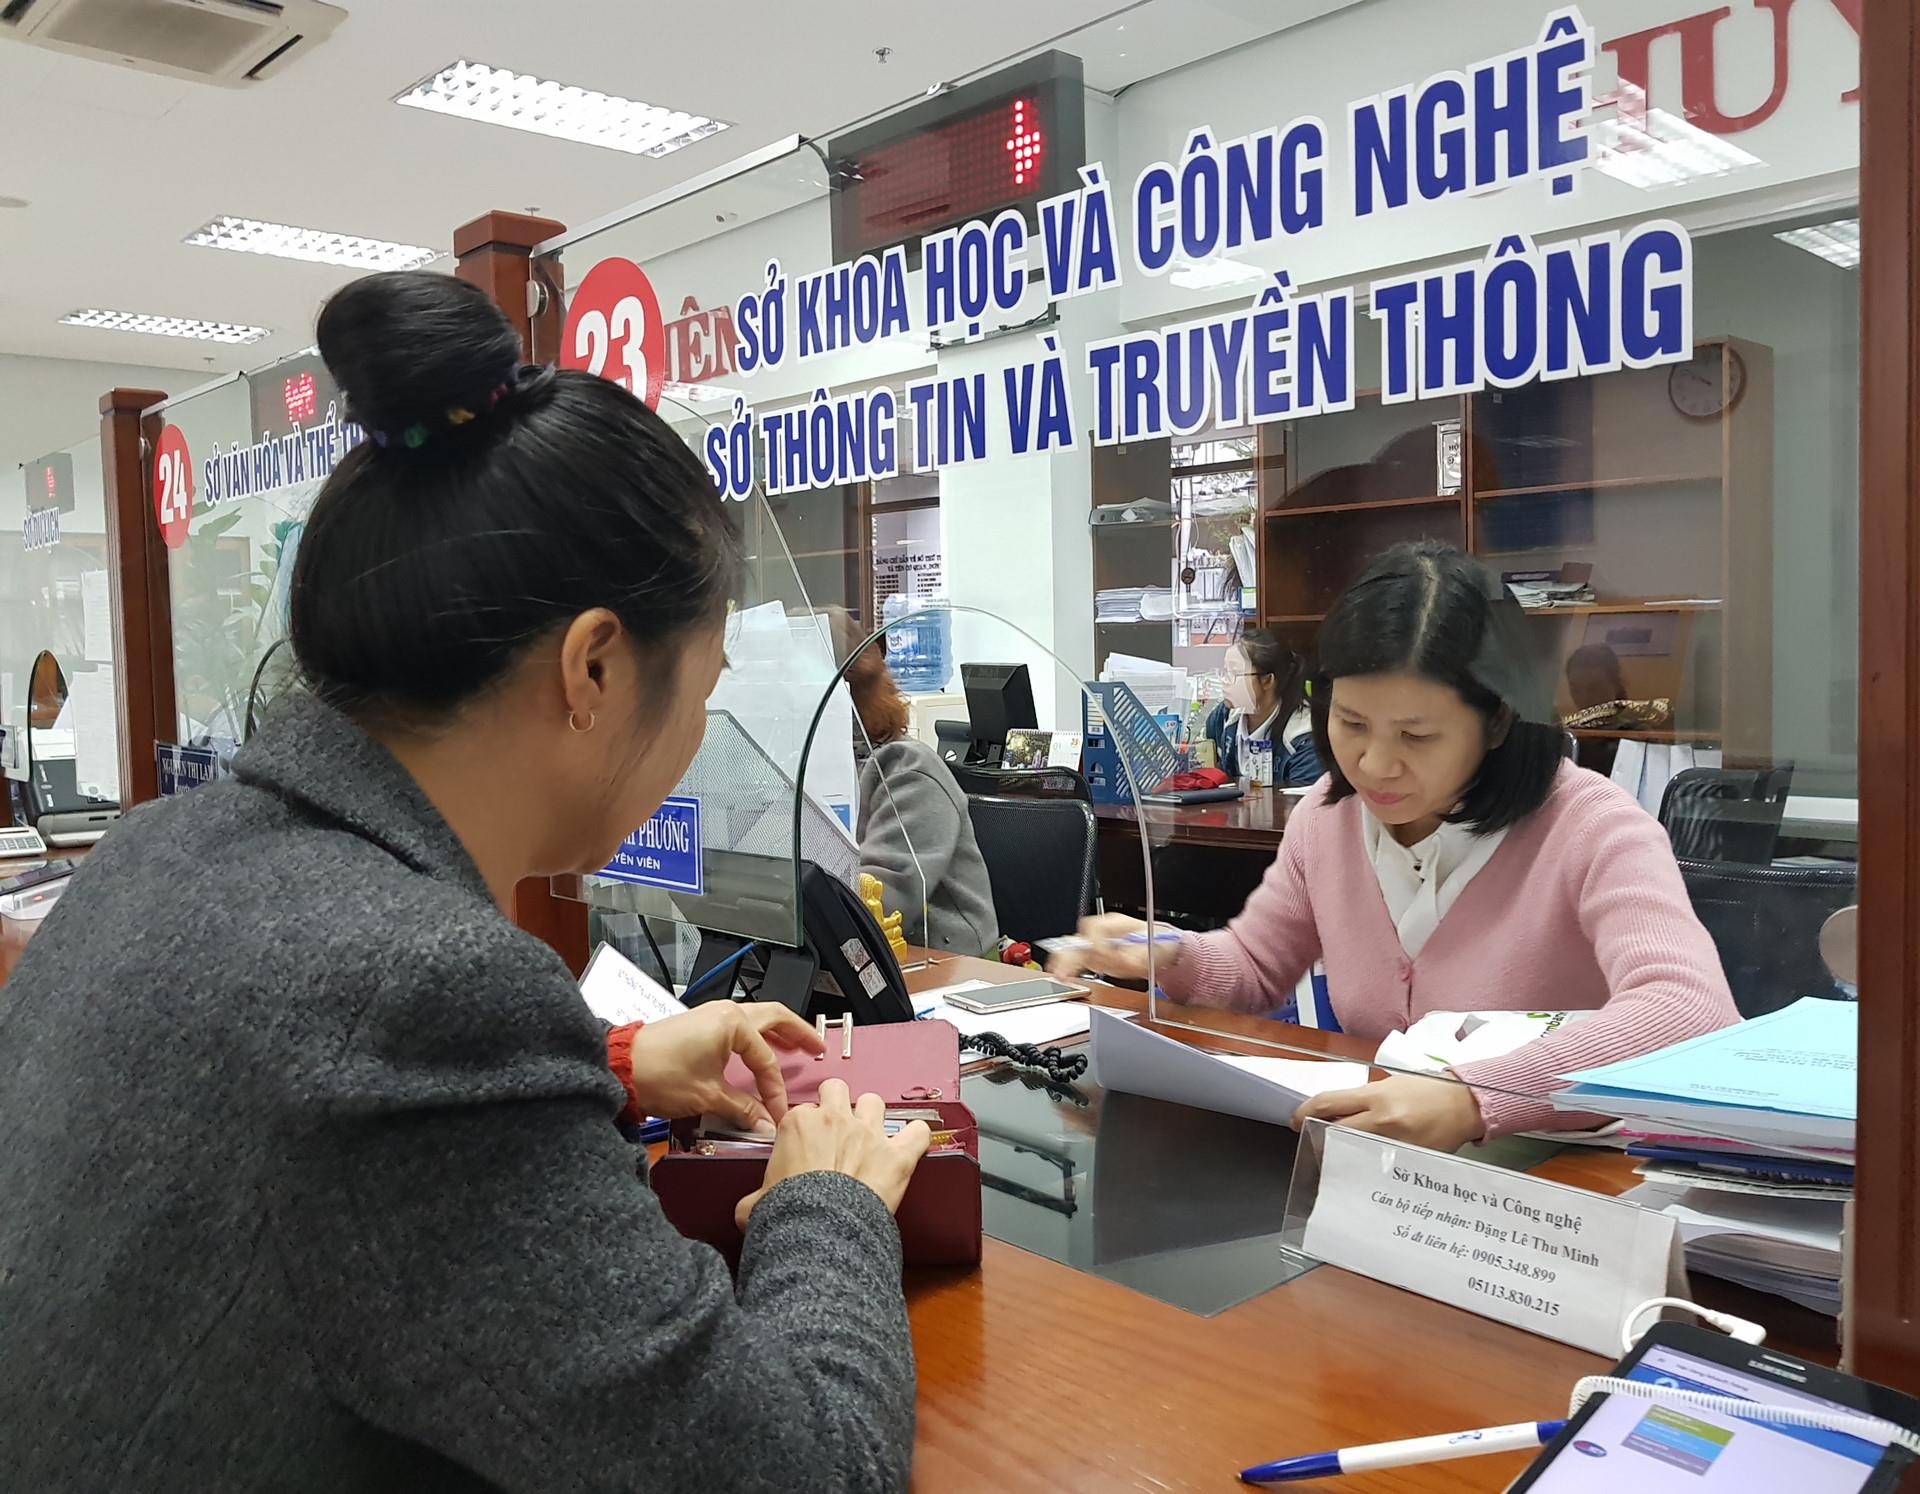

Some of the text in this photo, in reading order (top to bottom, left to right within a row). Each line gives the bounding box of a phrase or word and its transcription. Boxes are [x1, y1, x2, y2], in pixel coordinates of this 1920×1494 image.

[737, 16, 1588, 371] SỞ KHOA HỌC VÀ CÔNG NGHỆ
[576, 296, 647, 404] 23
[707, 230, 1683, 497] SỞ THÔNG TIN VÀ TRUYỀN THÔNG
[159, 450, 187, 524] 24
[205, 402, 363, 502] SỞ VĂN HÓA VÀ THỂ TH
[610, 851, 660, 870] YÊN VIÊN
[639, 812, 689, 853] PHƯƠNG
[1371, 1190, 1599, 1267] Cán bộ tiếp nhận: Đặng Lê Thu Minh
[1392, 1167, 1582, 1234] Sở Khoa học và Công nghệ
[1393, 1224, 1412, 1239] Số
[1424, 1234, 1447, 1250] liên
[1449, 1242, 1470, 1258] hệ:
[1472, 1248, 1556, 1283] 0905.348.899
[1468, 1276, 1560, 1316] 05113.830.215
